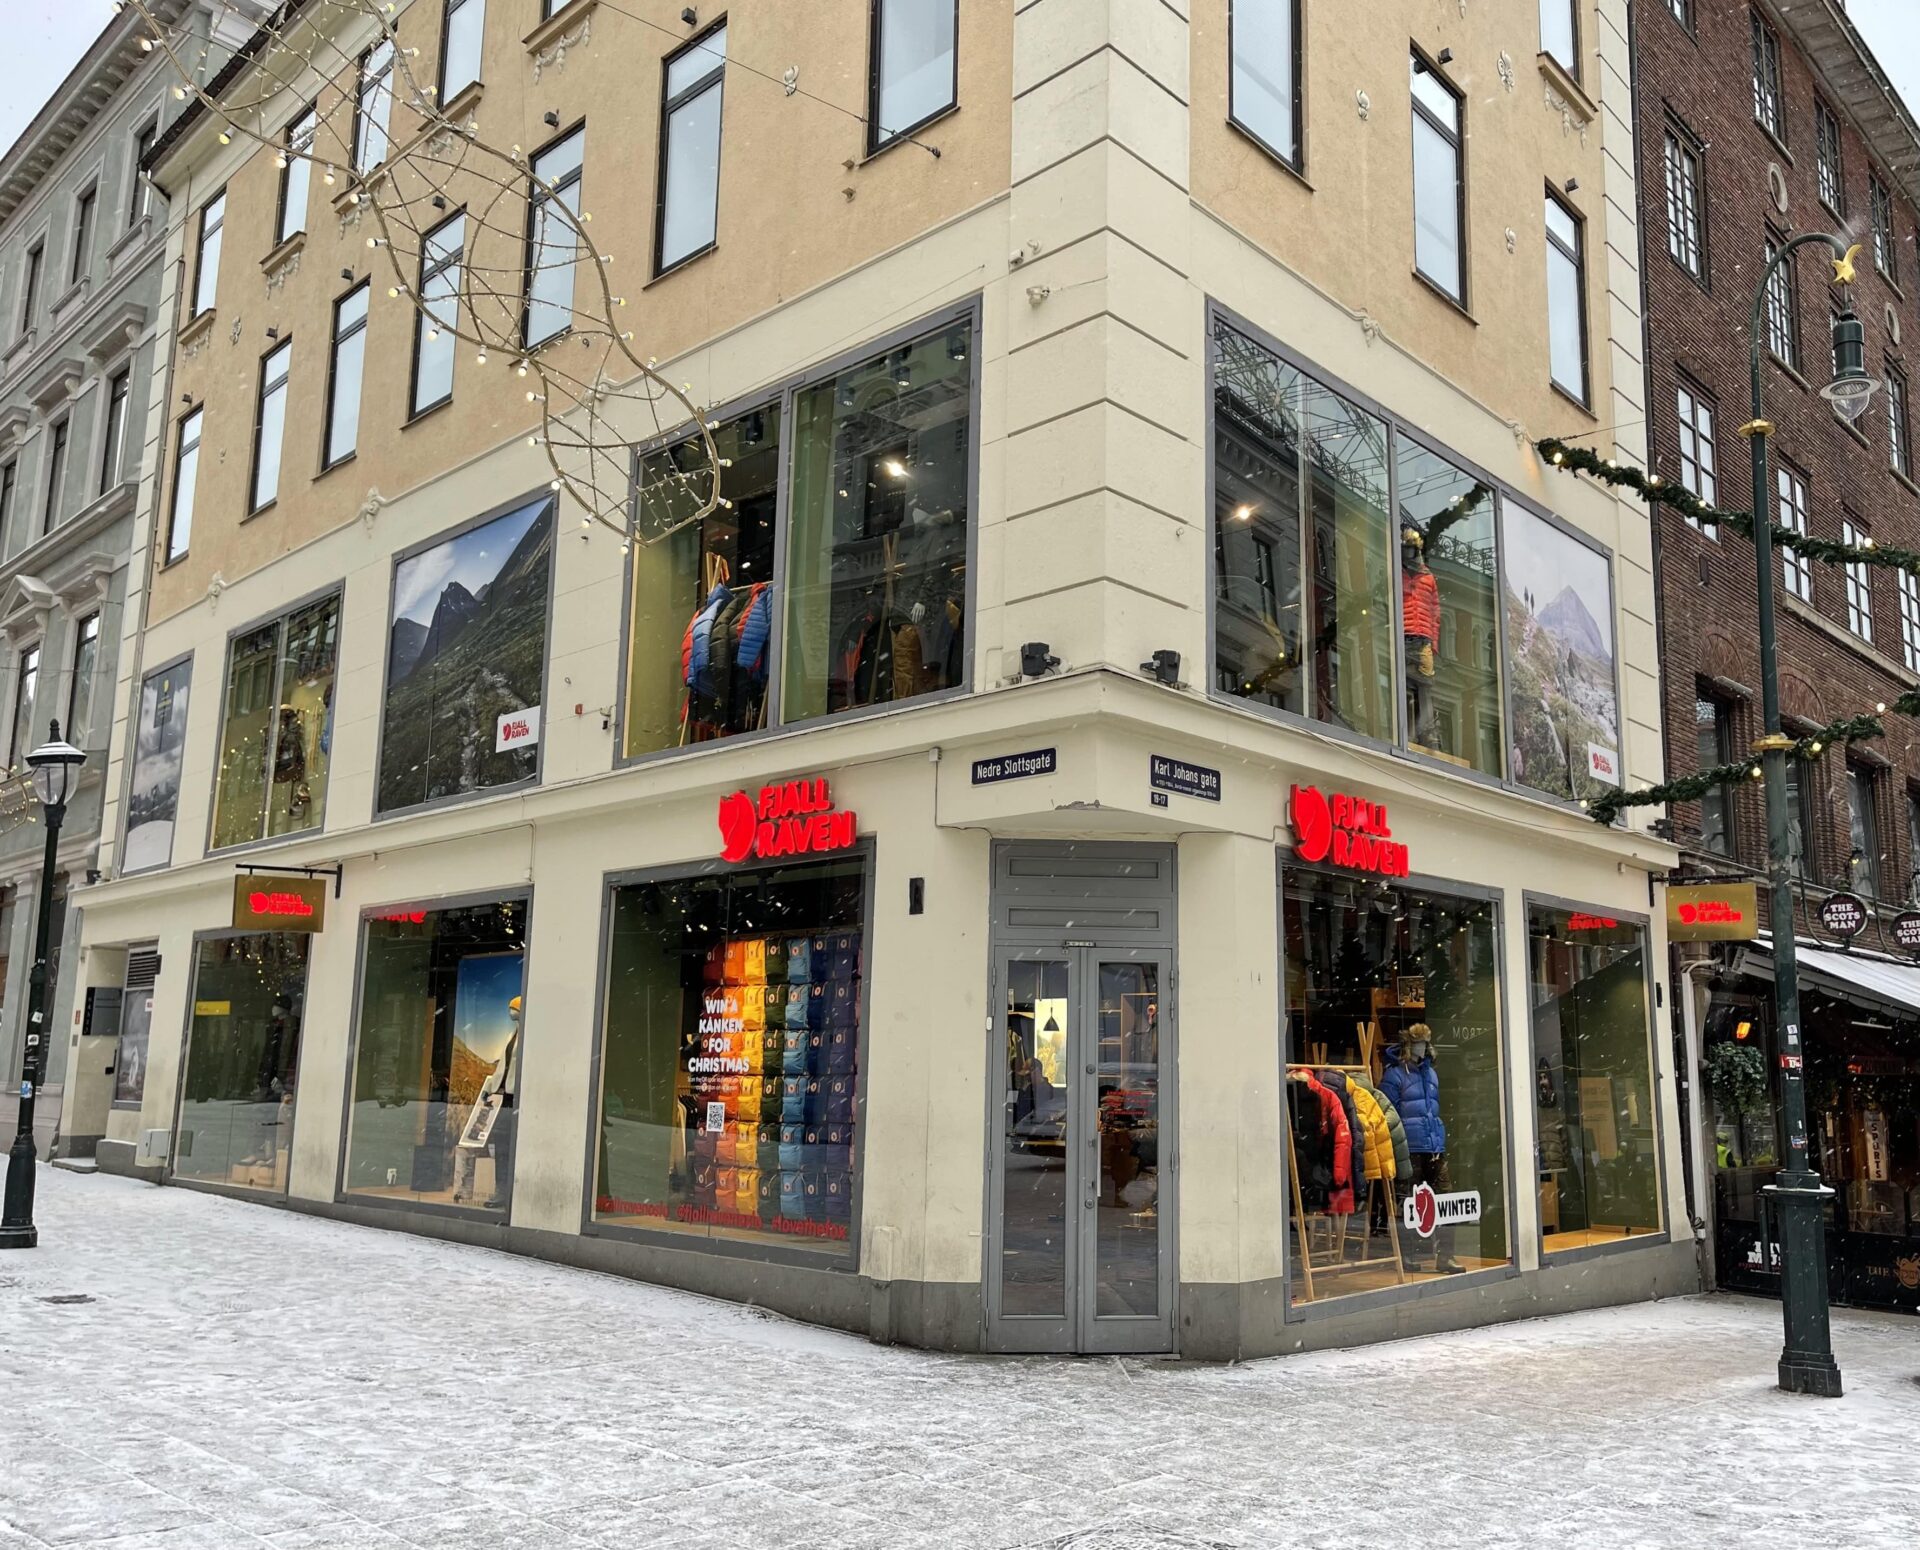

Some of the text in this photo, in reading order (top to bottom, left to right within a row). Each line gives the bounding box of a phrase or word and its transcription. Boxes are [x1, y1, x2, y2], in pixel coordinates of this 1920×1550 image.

[977, 754, 1051, 779] Nedre Slottsgate
[1154, 759, 1170, 777] Karl
[1173, 763, 1198, 783] Johans
[1200, 773, 1217, 789] gate
[758, 776, 832, 820] FJÄLL
[1332, 792, 1392, 838] FJÄLL
[756, 810, 857, 858] RÄVEN
[1332, 829, 1409, 878] RÄVEN
[1824, 911, 1860, 921] SCOTS
[1830, 904, 1854, 912] THE
[1829, 920, 1856, 929] MAN
[705, 998, 738, 1014] WIN A
[708, 1038, 731, 1053] FOR
[688, 1057, 750, 1073] CHRISTMAS
[1871, 1122, 1882, 1179] SPORTS
[1409, 1198, 1478, 1222] I WINTER
